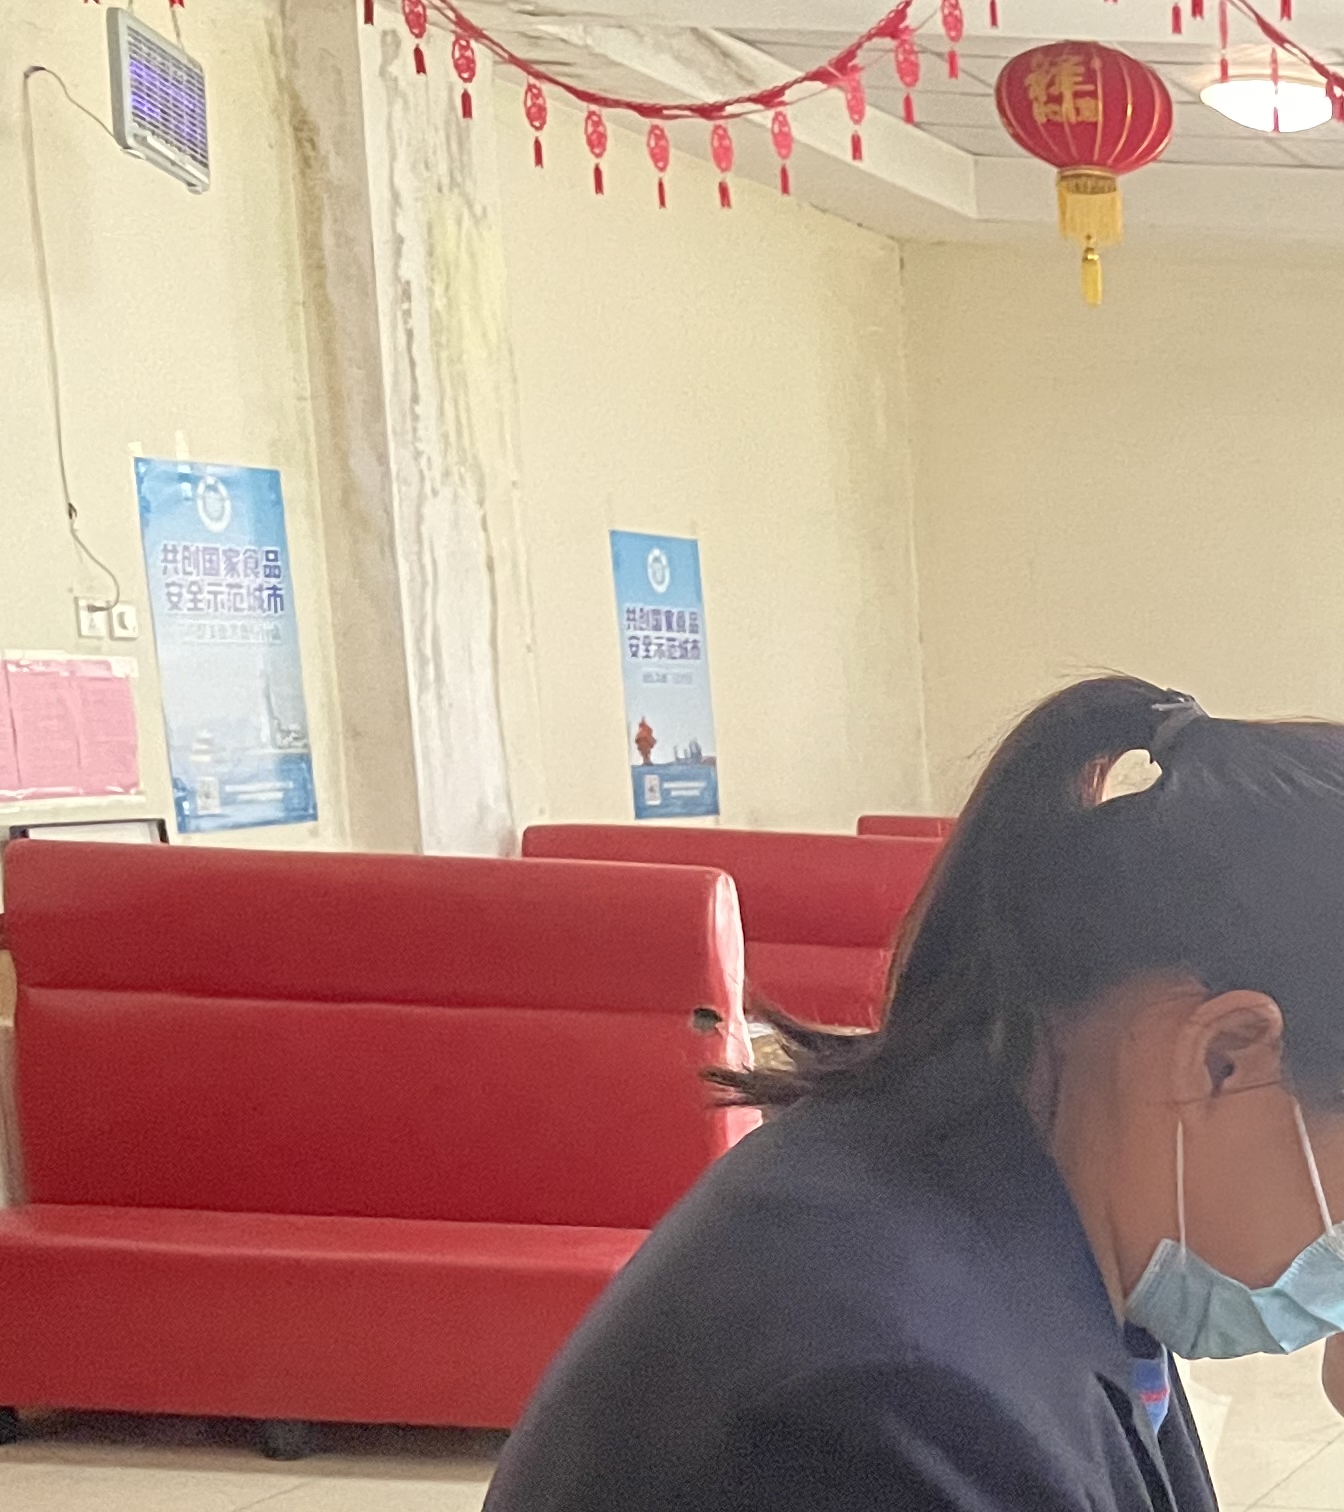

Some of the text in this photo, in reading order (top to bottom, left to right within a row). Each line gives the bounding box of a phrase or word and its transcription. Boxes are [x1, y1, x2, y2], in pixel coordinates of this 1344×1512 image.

[161, 543, 282, 579] 共创国家食品
[164, 580, 285, 614] 安全示范城市
[626, 607, 699, 634] 共创国家食品
[628, 635, 701, 660] 安全示范城市
